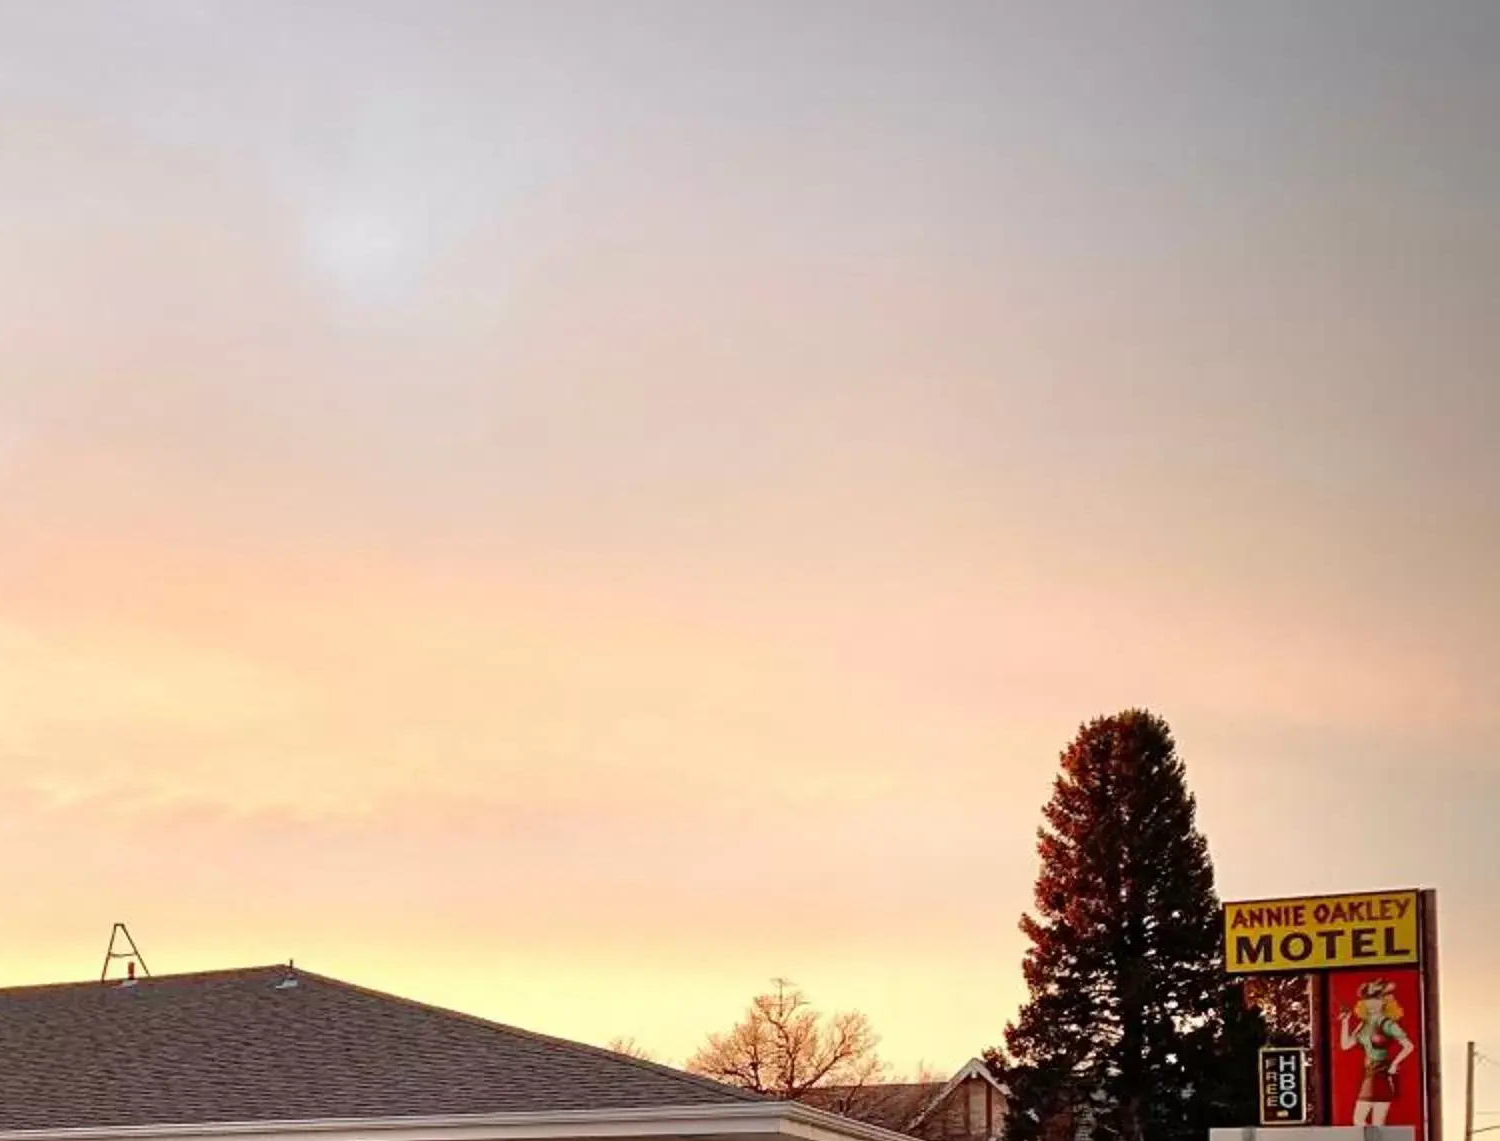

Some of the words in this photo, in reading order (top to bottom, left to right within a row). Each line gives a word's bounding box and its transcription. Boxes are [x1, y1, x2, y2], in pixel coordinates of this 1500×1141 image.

[1231, 906, 1306, 929] ANNIE
[1313, 898, 1411, 925] OAKLEY
[1235, 927, 1411, 964] MOTEL
[1279, 1055, 1298, 1109] HBO
